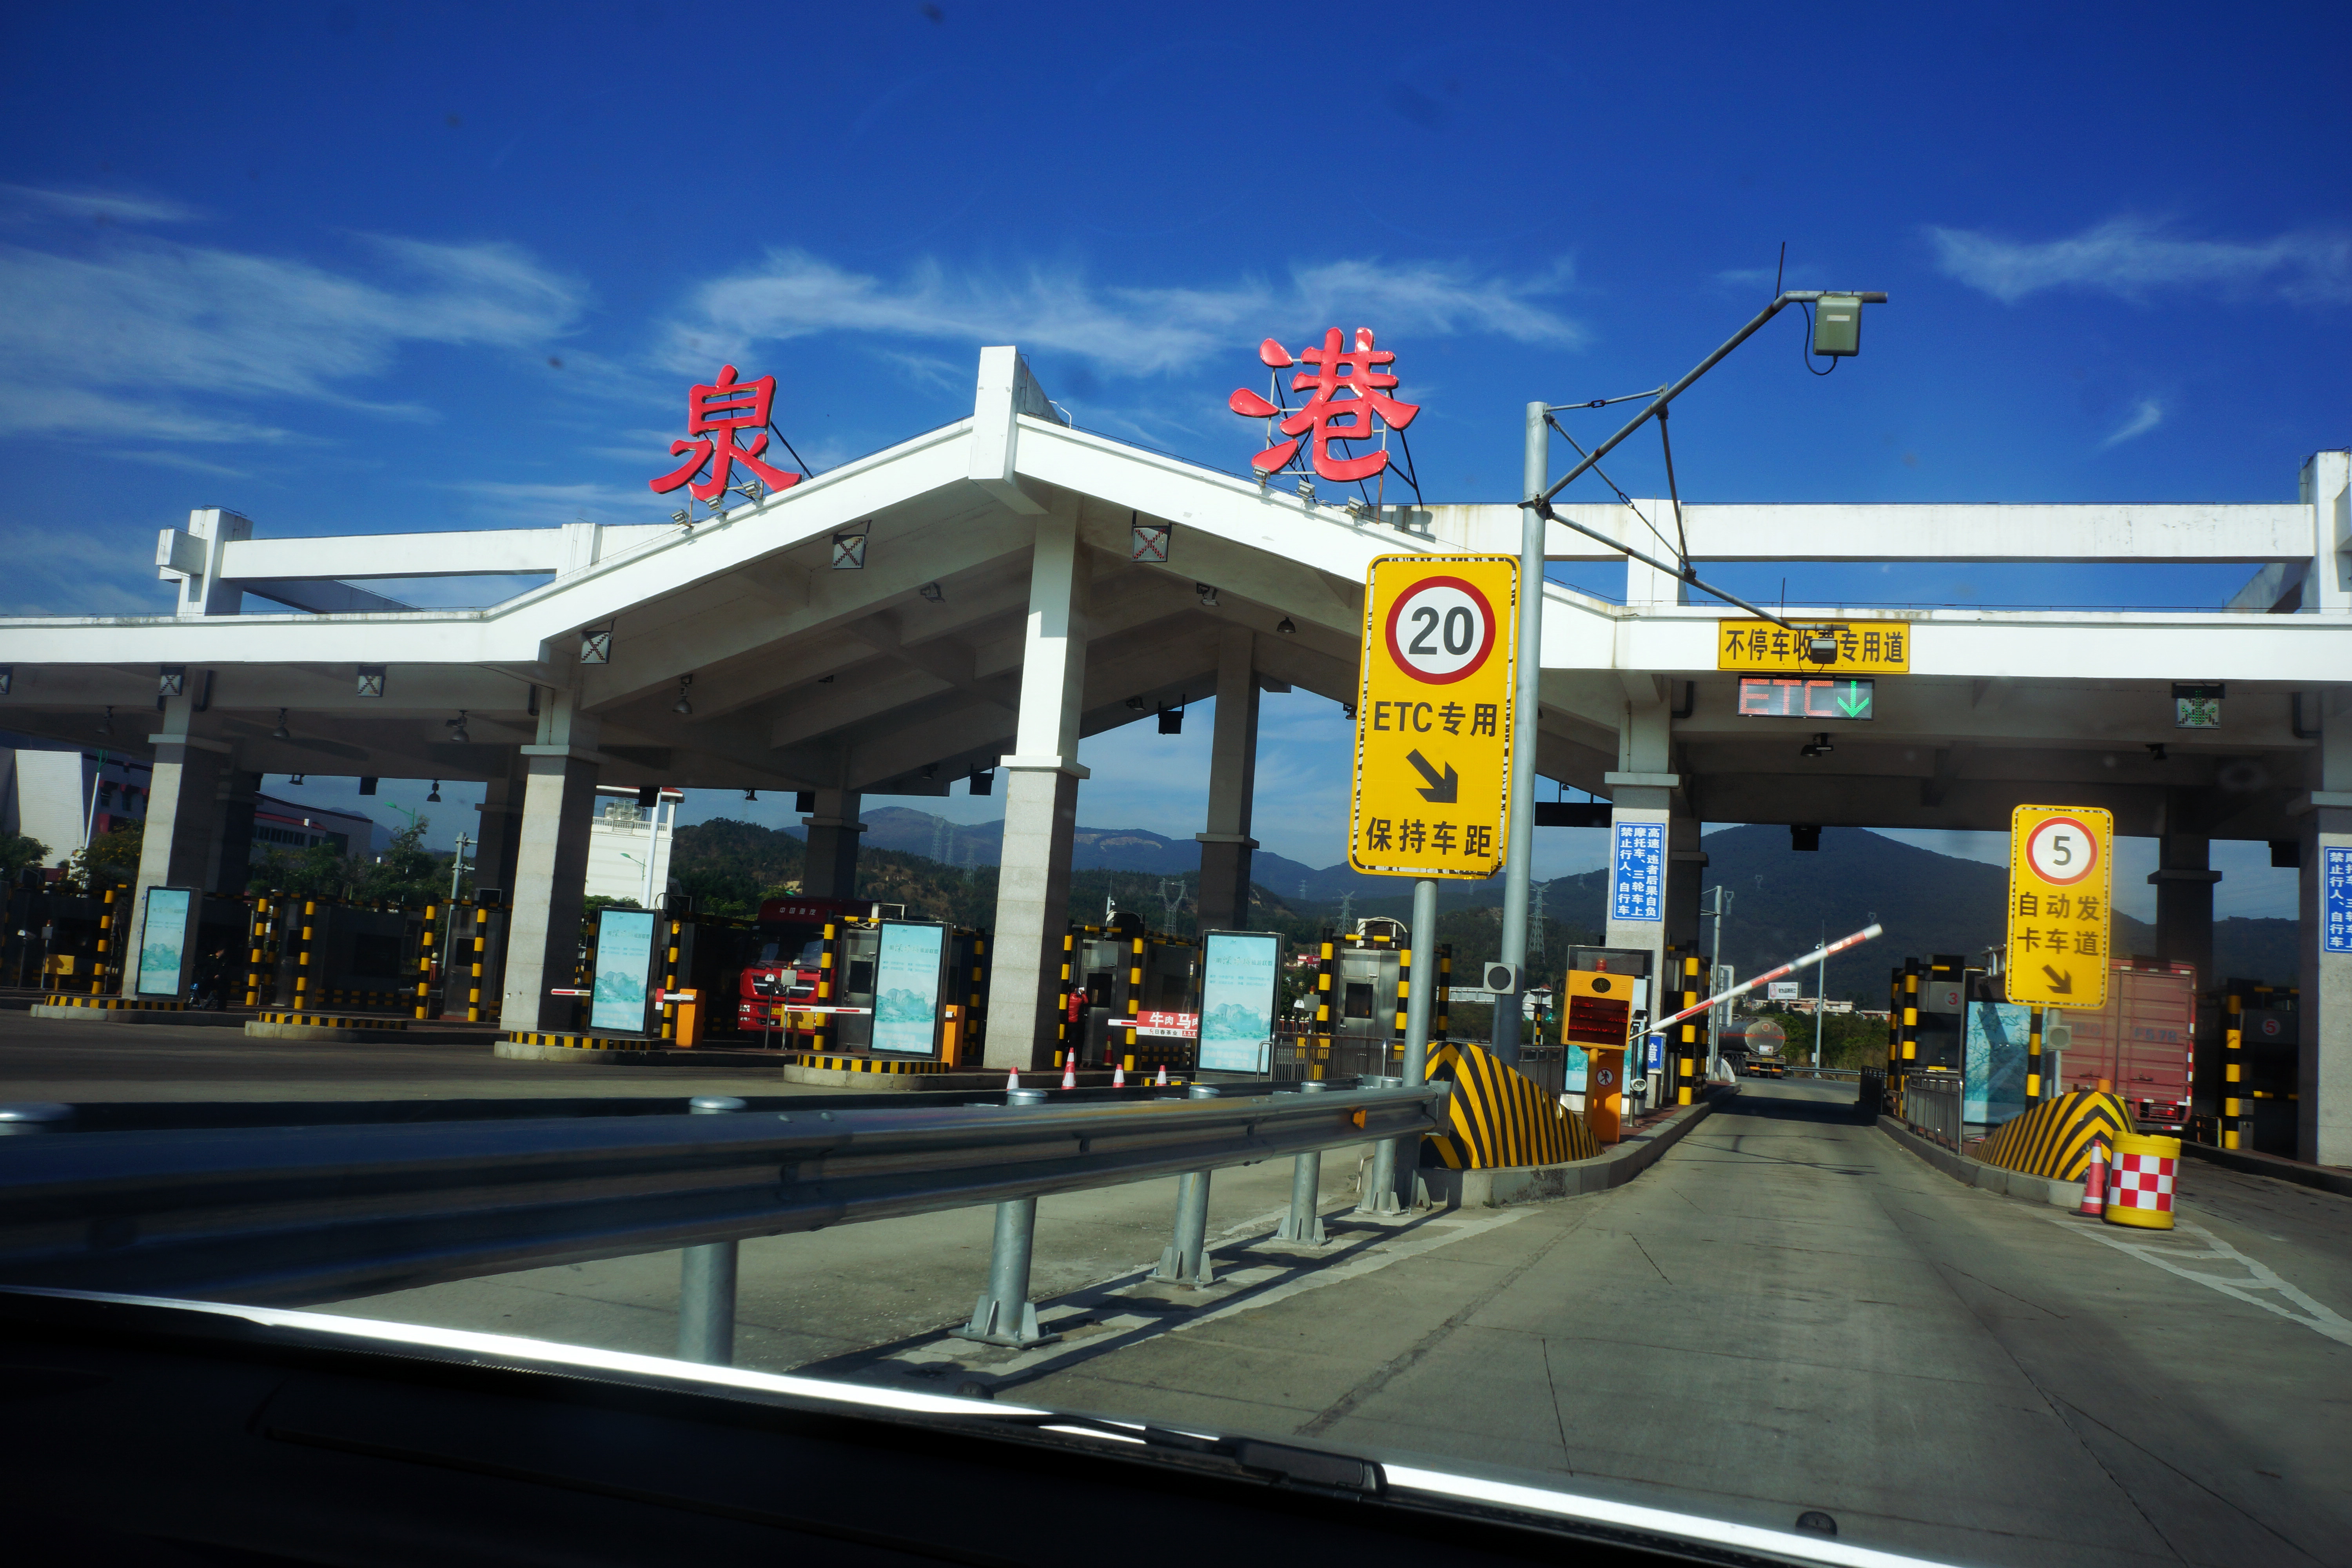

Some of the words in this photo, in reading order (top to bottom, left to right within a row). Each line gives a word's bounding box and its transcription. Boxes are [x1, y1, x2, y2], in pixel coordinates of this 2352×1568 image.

[649, 365, 802, 502] 泉
[1229, 327, 1419, 481] 港
[1409, 606, 1474, 655] 20
[1740, 678, 1834, 716] ETC
[1373, 701, 1497, 737] ETC专用
[1366, 817, 1492, 858] 保持车距
[2053, 835, 2072, 866] 5
[1617, 827, 1633, 915] 禁止行人、自行车
[1631, 828, 1647, 916] 摩托车、三轮车上
[1645, 828, 1661, 917] 高速、违者后果自负
[2020, 891, 2100, 921] 自动发
[2329, 852, 2345, 947] 禁止行人、自行车
[2017, 927, 2100, 956] 卡车道
[1948, 992, 1958, 1005] 3
[1149, 1011, 1174, 1027] 牛肉
[2265, 1020, 2277, 1033] 5
